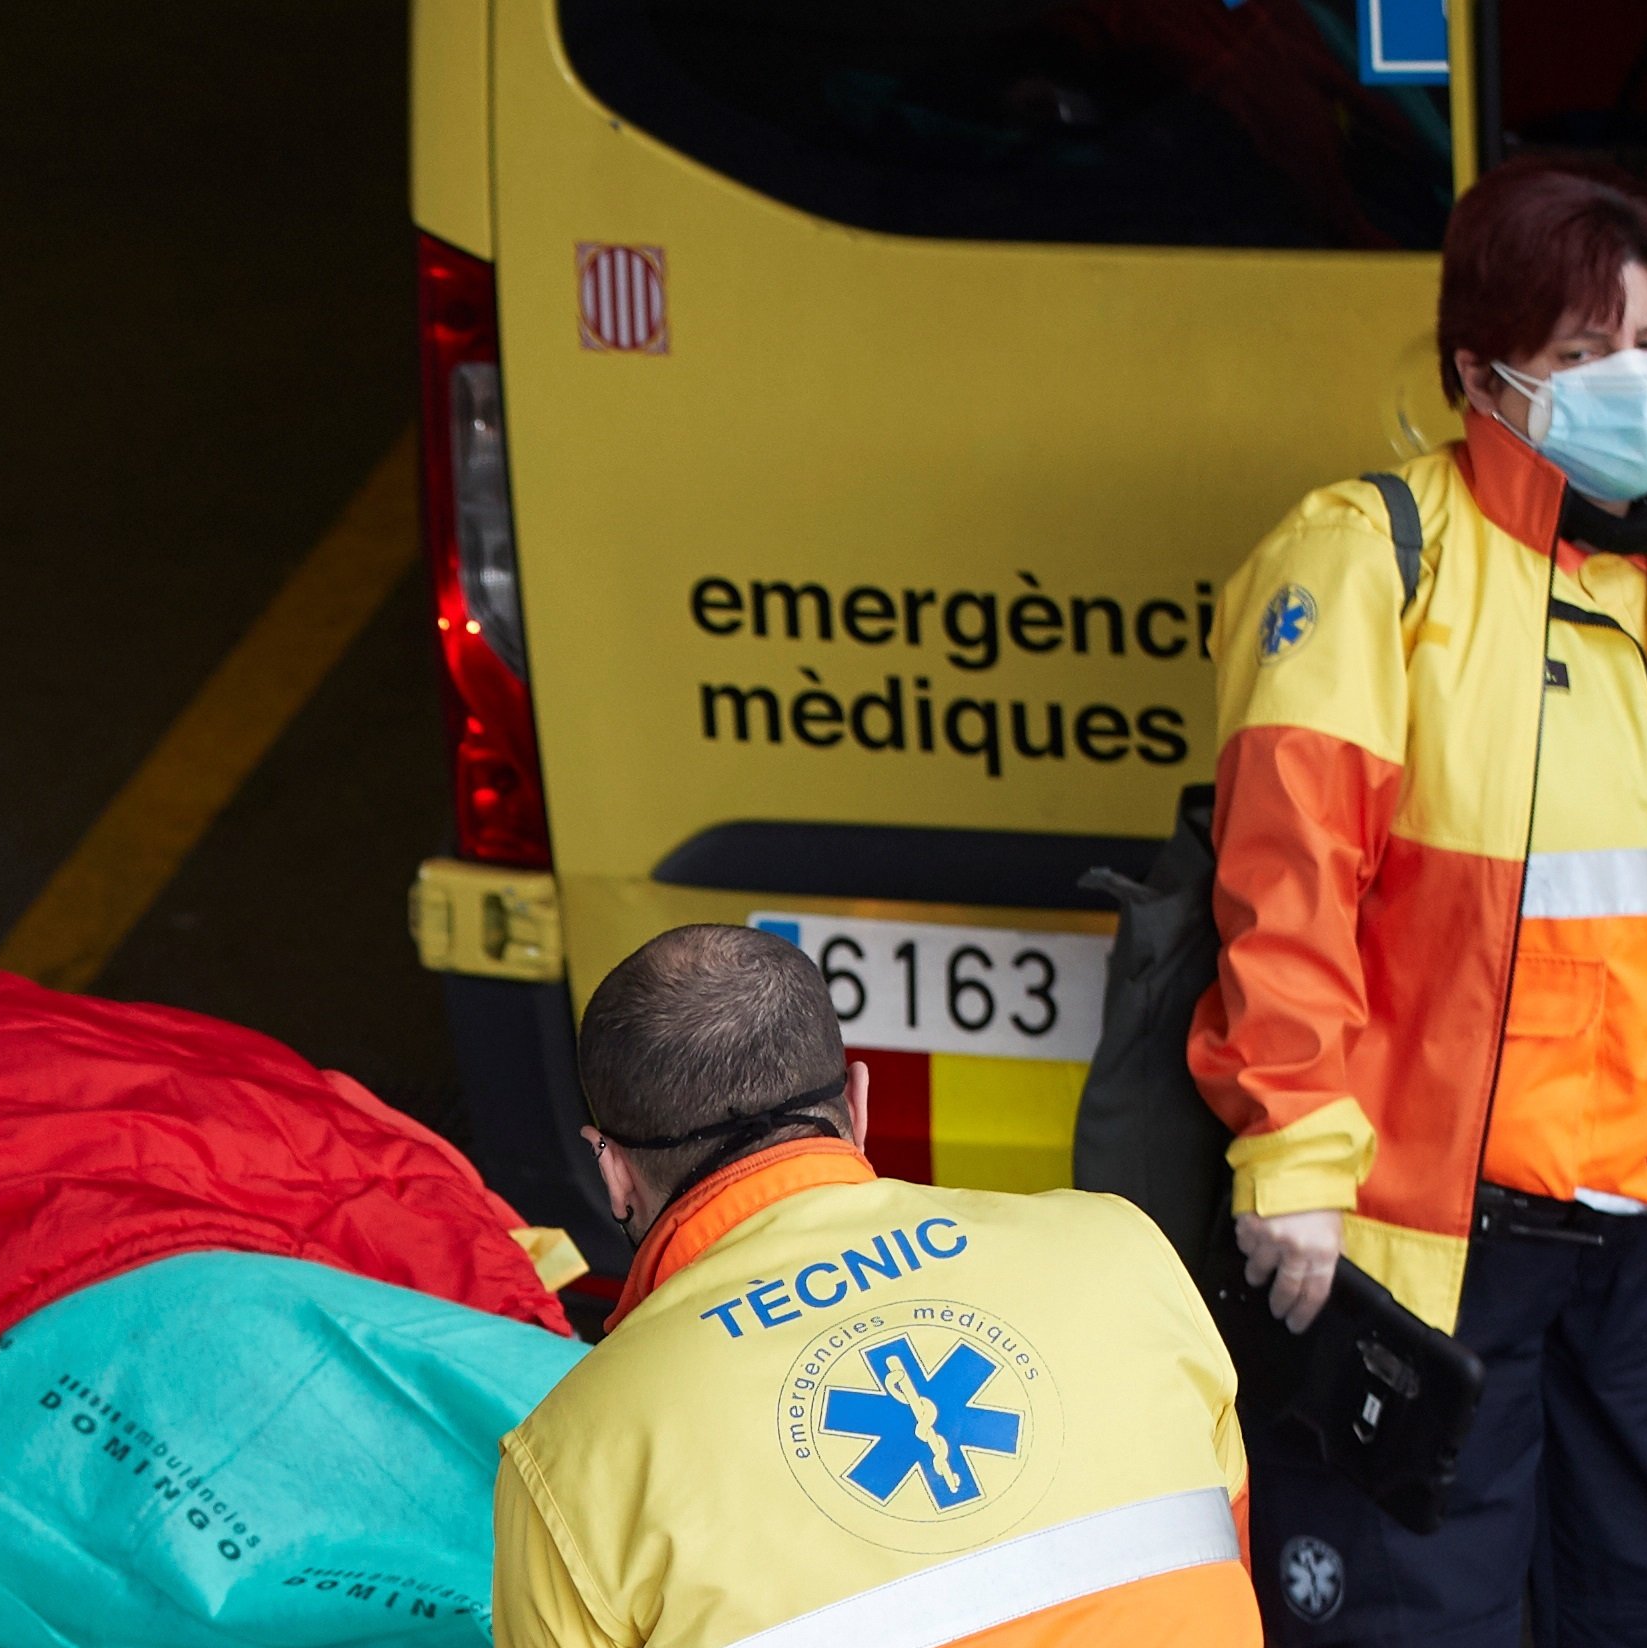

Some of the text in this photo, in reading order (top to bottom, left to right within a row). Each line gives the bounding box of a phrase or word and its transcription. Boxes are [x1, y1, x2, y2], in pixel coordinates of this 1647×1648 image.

[699, 666, 1188, 778] mèdiques
[821, 934, 1057, 1036] 6163
[699, 1217, 968, 1339] TÈCNIC
[38, 1390, 241, 1561] DOMINGO
